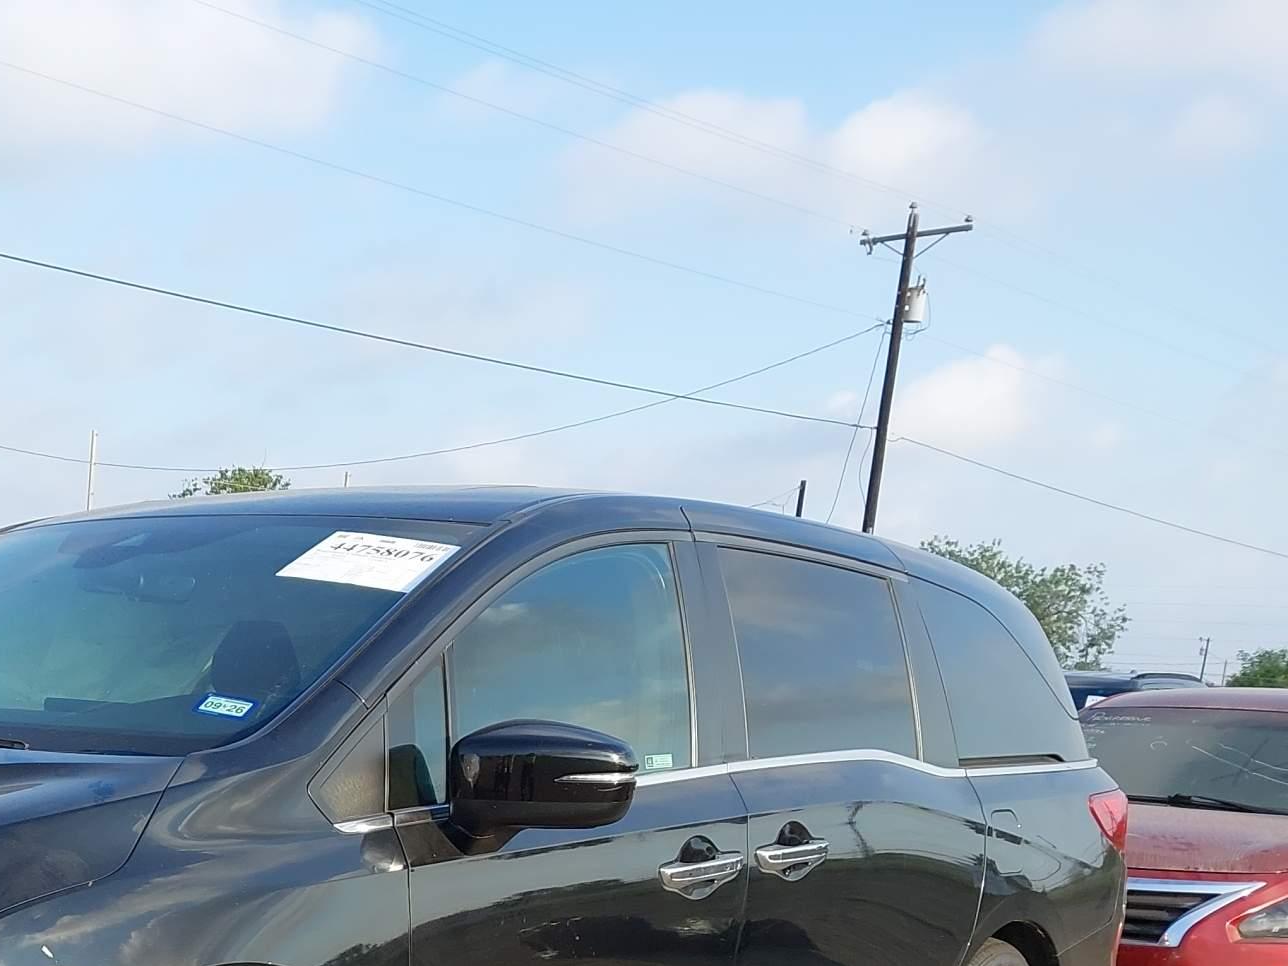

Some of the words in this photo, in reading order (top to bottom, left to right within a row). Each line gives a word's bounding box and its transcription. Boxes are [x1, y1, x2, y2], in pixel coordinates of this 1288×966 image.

[330, 542, 435, 562] 44758076
[204, 700, 222, 709] 09
[226, 704, 245, 714] 26
